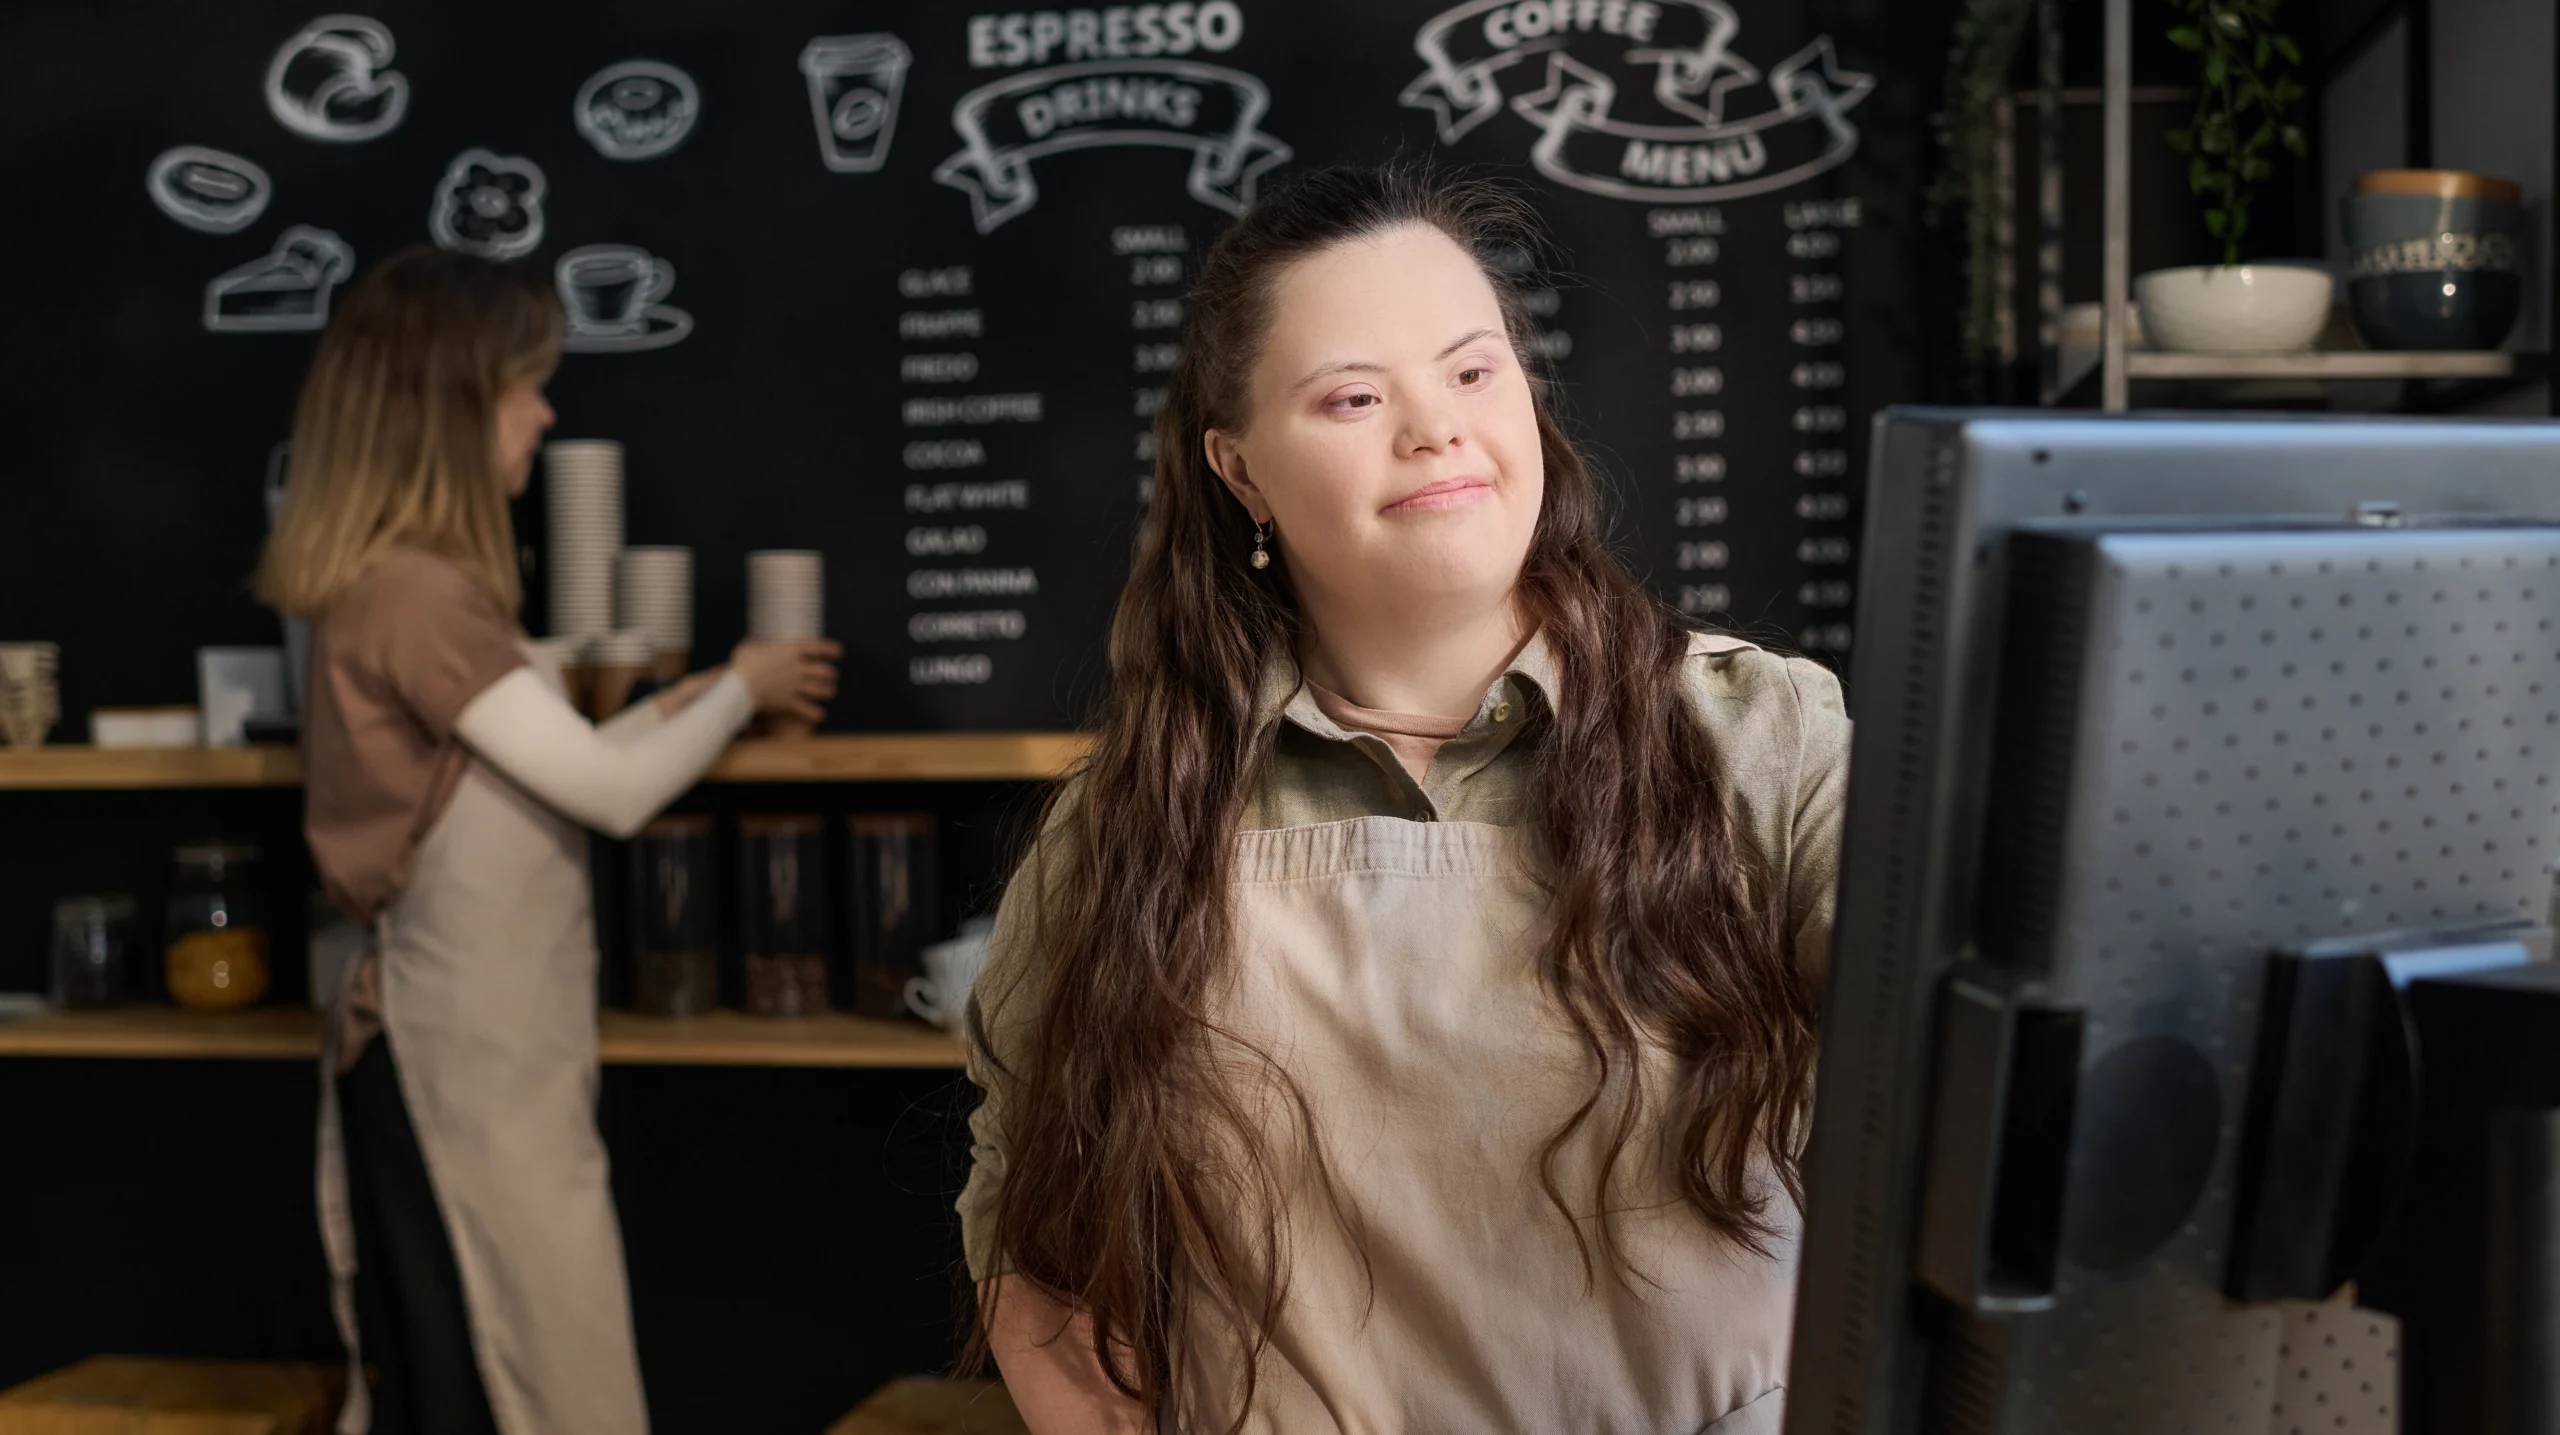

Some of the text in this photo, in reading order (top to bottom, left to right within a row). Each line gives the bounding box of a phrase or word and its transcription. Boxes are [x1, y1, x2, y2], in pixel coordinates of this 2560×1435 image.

[968, 2, 1243, 67] ESPRESSO
[1483, 0, 1660, 48] COFFEE
[1017, 77, 1202, 139] DRINKS
[1619, 129, 1767, 185] MENU
[1648, 209, 1725, 237] SMALL
[1112, 226, 1186, 254] SMALL
[903, 392, 1042, 425] IRISH COFFEE
[903, 441, 985, 469] COCOA
[905, 480, 1027, 512] FLAT WHITE
[906, 526, 986, 555] GALAO
[961, 567, 1038, 596] PANNA
[908, 609, 1027, 642] CORRETTO
[909, 654, 993, 685] LUNGO
